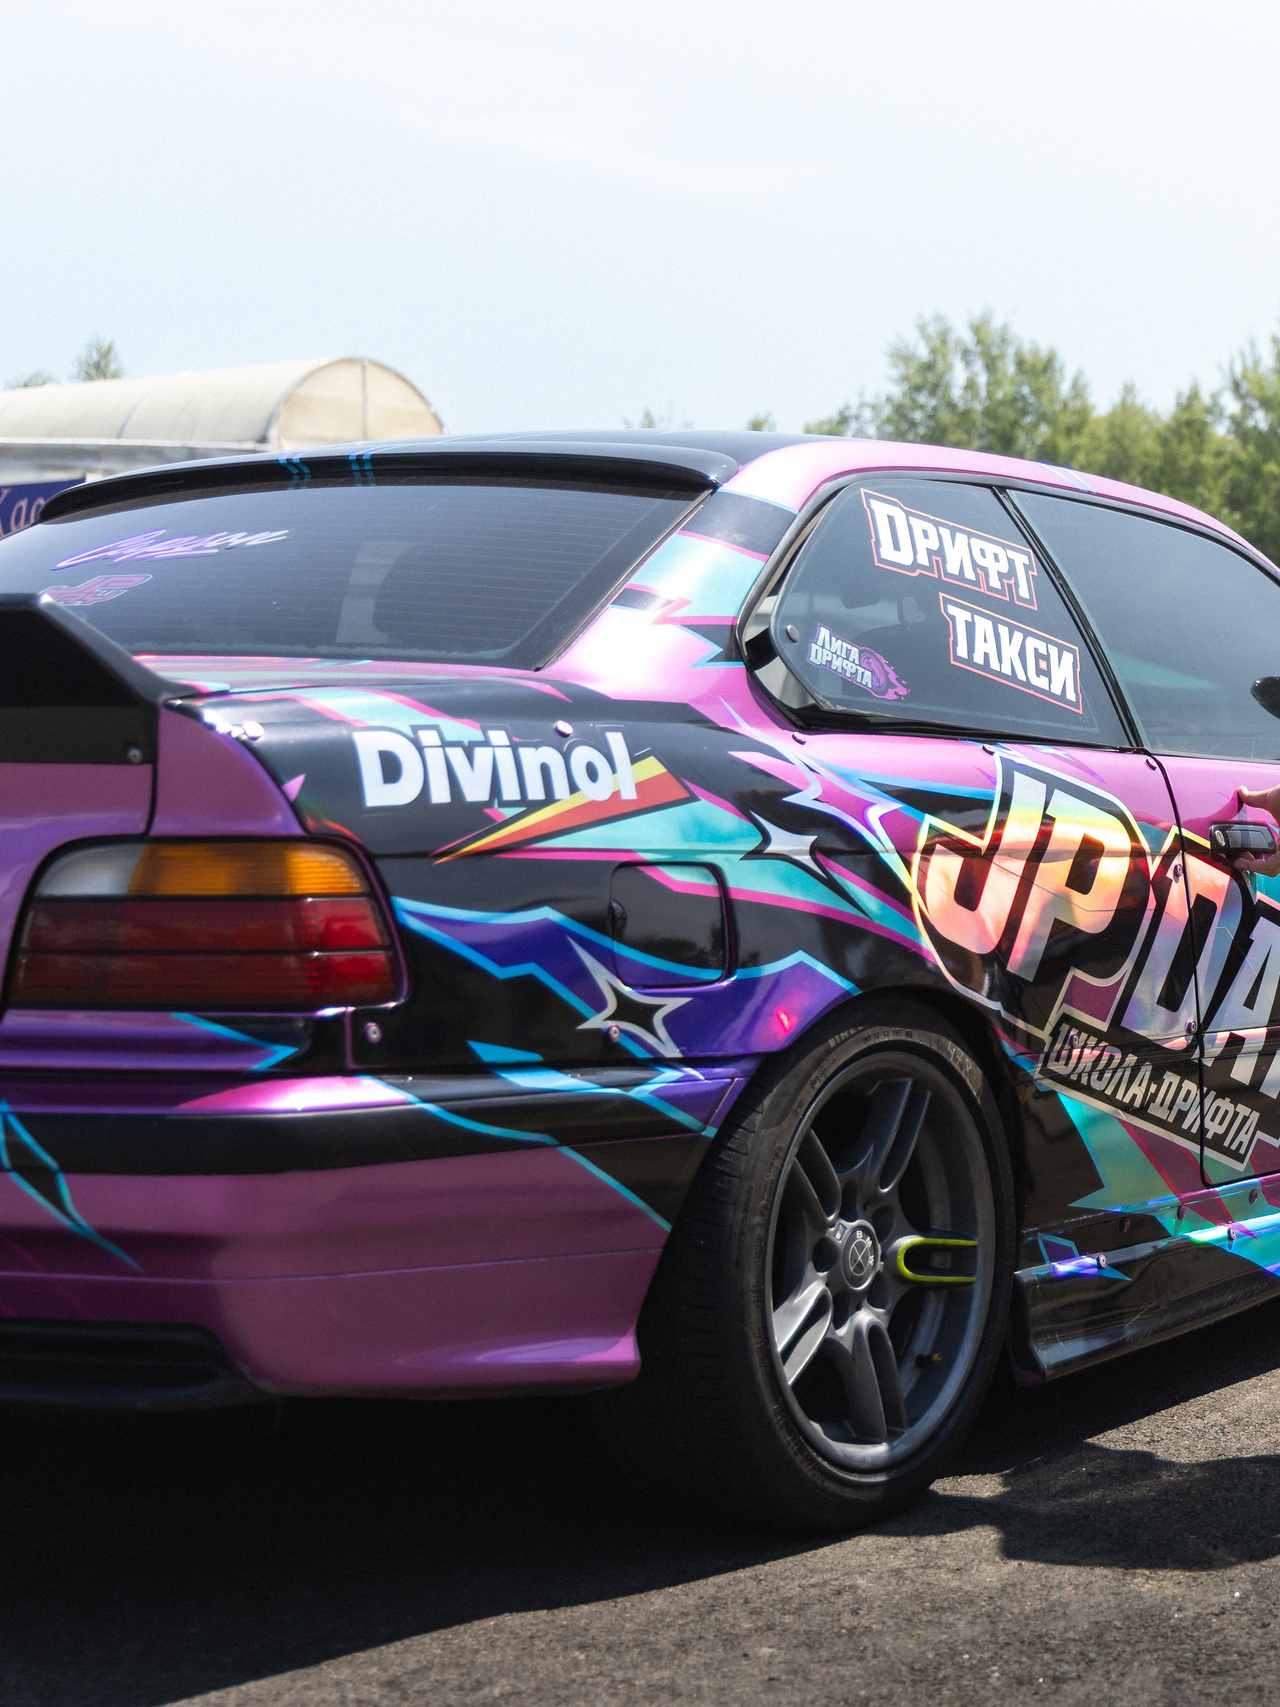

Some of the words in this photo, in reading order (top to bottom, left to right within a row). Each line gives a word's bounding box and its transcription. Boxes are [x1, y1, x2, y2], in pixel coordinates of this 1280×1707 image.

[817, 626, 860, 664] ЛИГА
[946, 604, 1077, 702] ТАКСИ
[352, 729, 638, 807] Divinol
[856, 1230, 875, 1266] BMW
